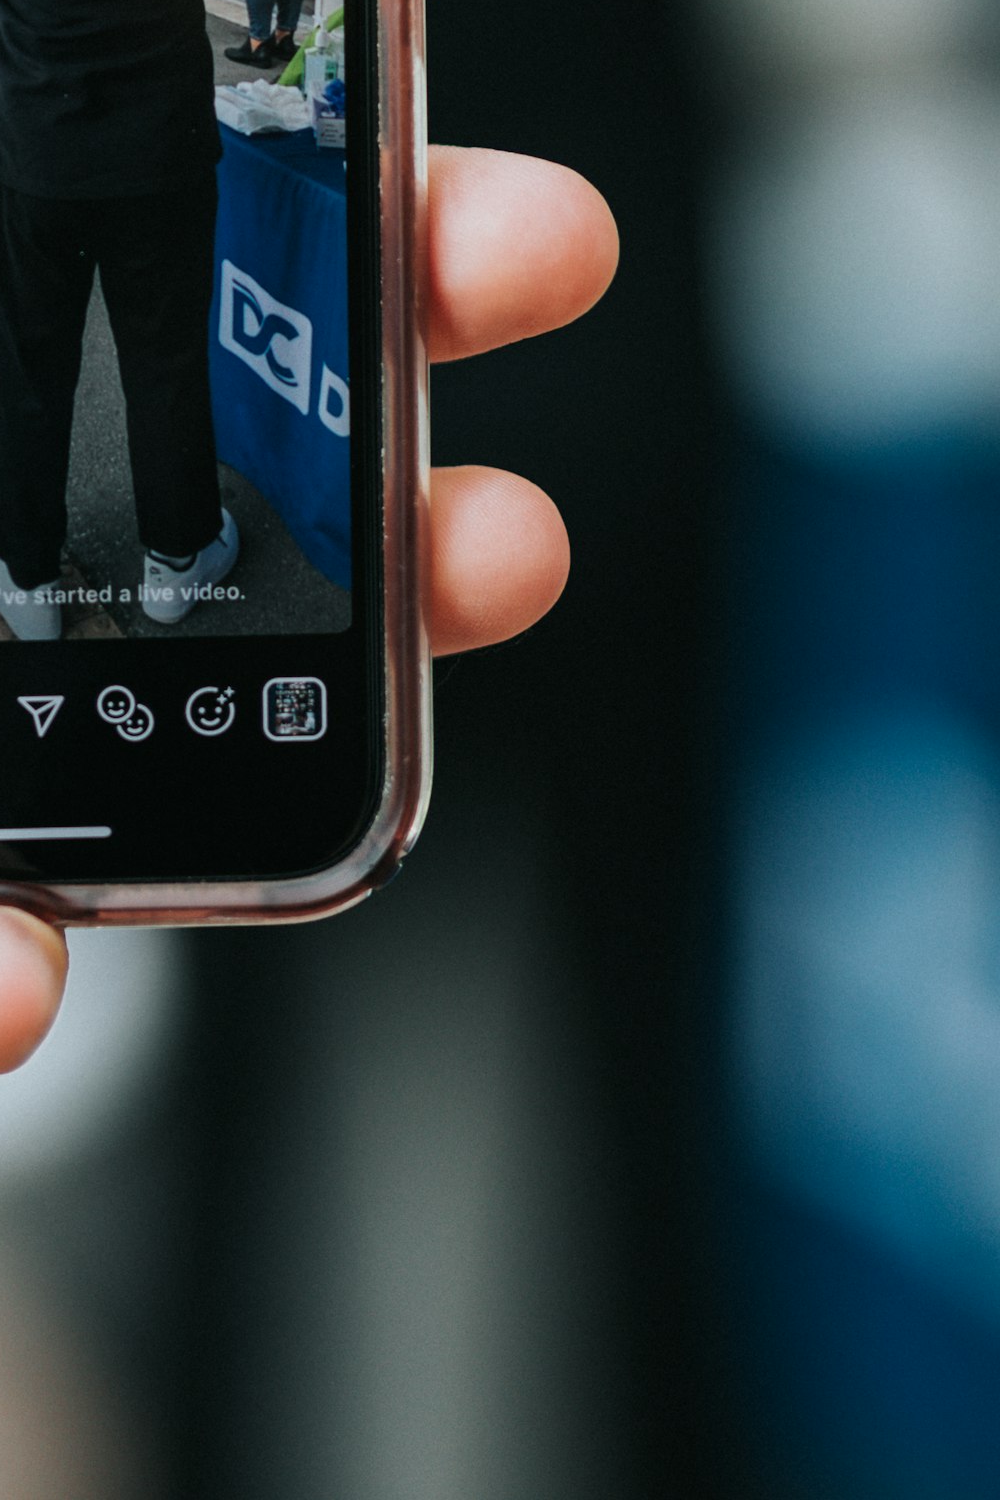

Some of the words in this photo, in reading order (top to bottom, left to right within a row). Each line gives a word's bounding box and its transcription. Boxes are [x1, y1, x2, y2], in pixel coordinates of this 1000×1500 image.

[33, 585, 112, 604] started
[119, 588, 131, 602] a
[138, 582, 174, 601] live
[180, 581, 246, 601] video.
